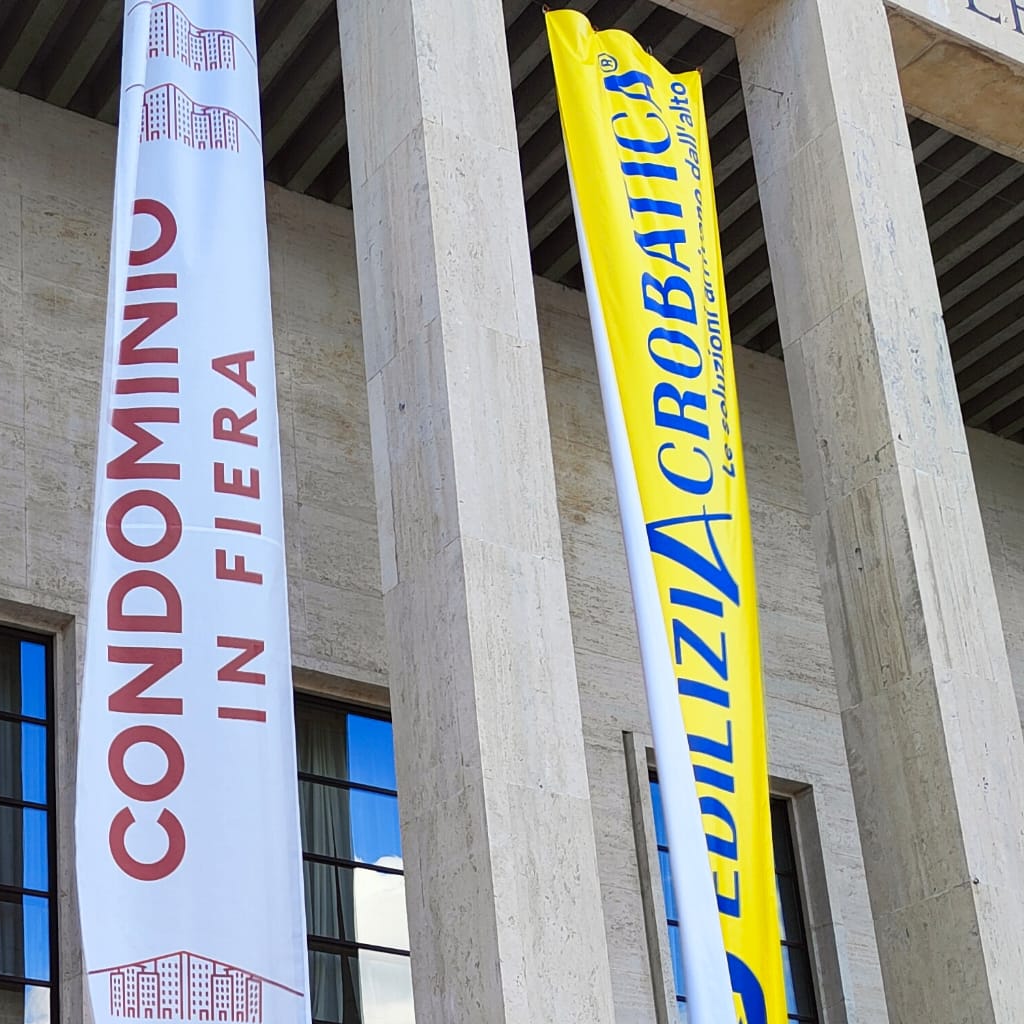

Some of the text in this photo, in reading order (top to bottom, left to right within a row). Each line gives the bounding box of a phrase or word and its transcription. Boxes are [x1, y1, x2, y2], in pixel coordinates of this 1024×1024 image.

[106, 198, 186, 882] CONDOMINIO
[212, 350, 266, 723] IN FIERA
